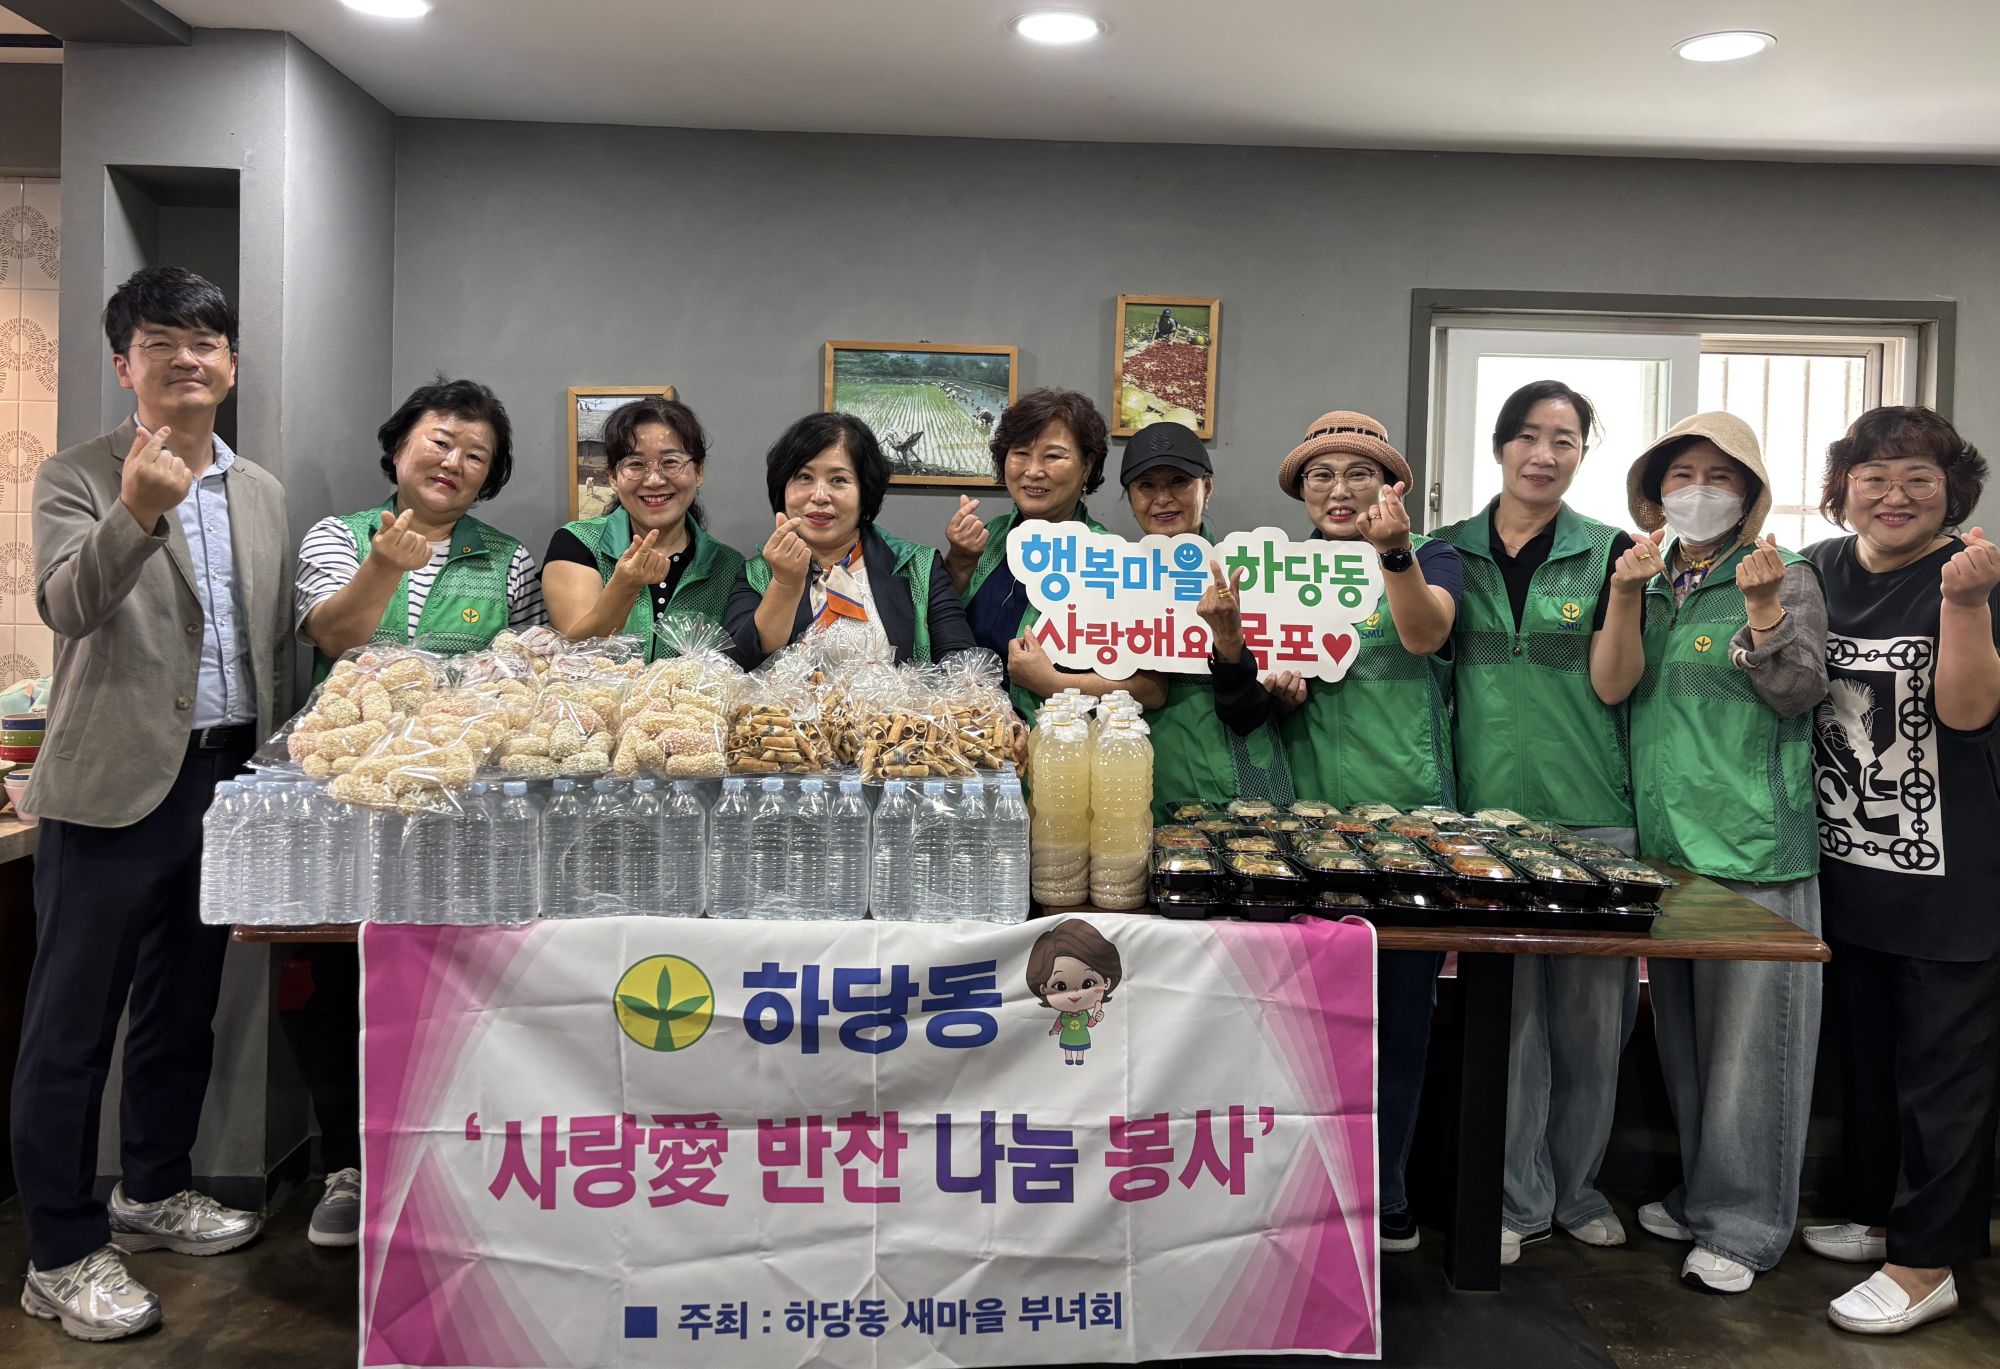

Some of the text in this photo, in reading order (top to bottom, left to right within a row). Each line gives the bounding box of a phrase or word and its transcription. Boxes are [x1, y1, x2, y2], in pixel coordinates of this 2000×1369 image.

[1021, 534, 1370, 609] 행복마을 하당동
[1035, 603, 1319, 671] 사랑해요 목포
[744, 959, 1003, 1055] 하당동
[757, 1110, 908, 1204] 반찬
[936, 1112, 1079, 1204] 나눔
[151, 1208, 185, 1232] N
[678, 1302, 748, 1340] 주최
[785, 1301, 889, 1338] 하당동
[902, 1298, 1006, 1335] 새마을
[1018, 1292, 1123, 1331] 부녀회
